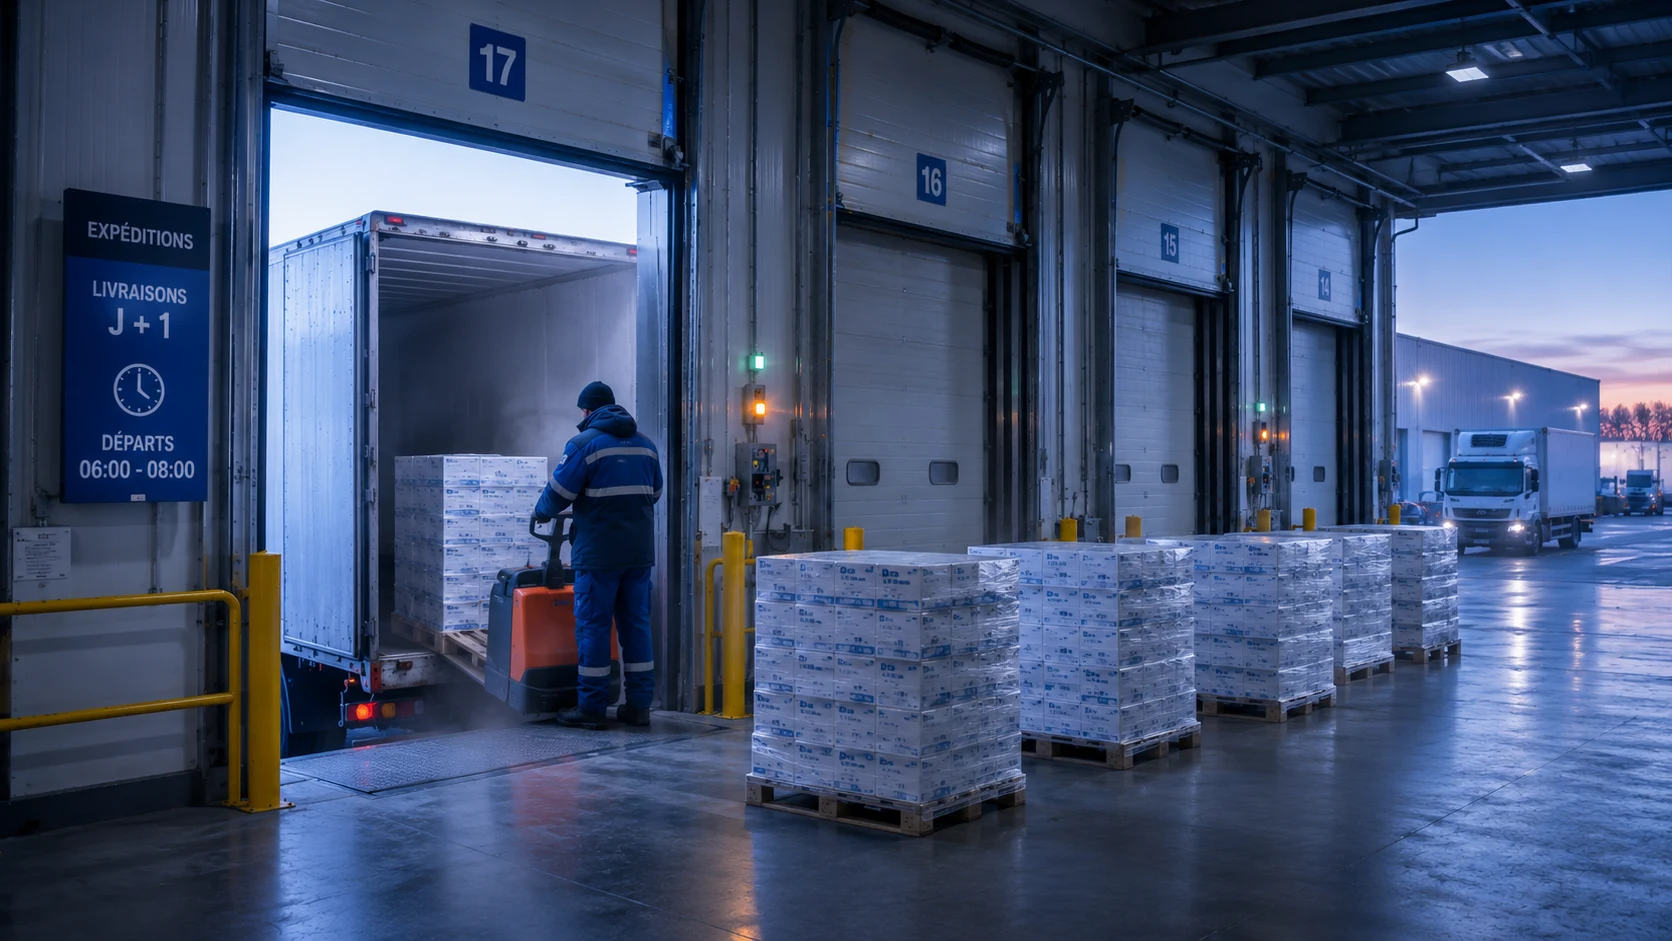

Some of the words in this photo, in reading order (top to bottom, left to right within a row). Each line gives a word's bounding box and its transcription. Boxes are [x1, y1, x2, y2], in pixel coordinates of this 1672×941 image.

[479, 43, 517, 86] 17
[921, 165, 942, 197] 16
[87, 220, 194, 250] EXPÉDITIONS
[1164, 232, 1177, 257] 15
[92, 280, 188, 305] LIVRAISONS
[1320, 276, 1330, 297] 14
[108, 308, 124, 336] J
[133, 316, 150, 334] +
[159, 312, 171, 339] 1
[101, 431, 175, 452] DÉPARTS
[79, 459, 131, 479] 06:00
[147, 460, 195, 479] 08:00
